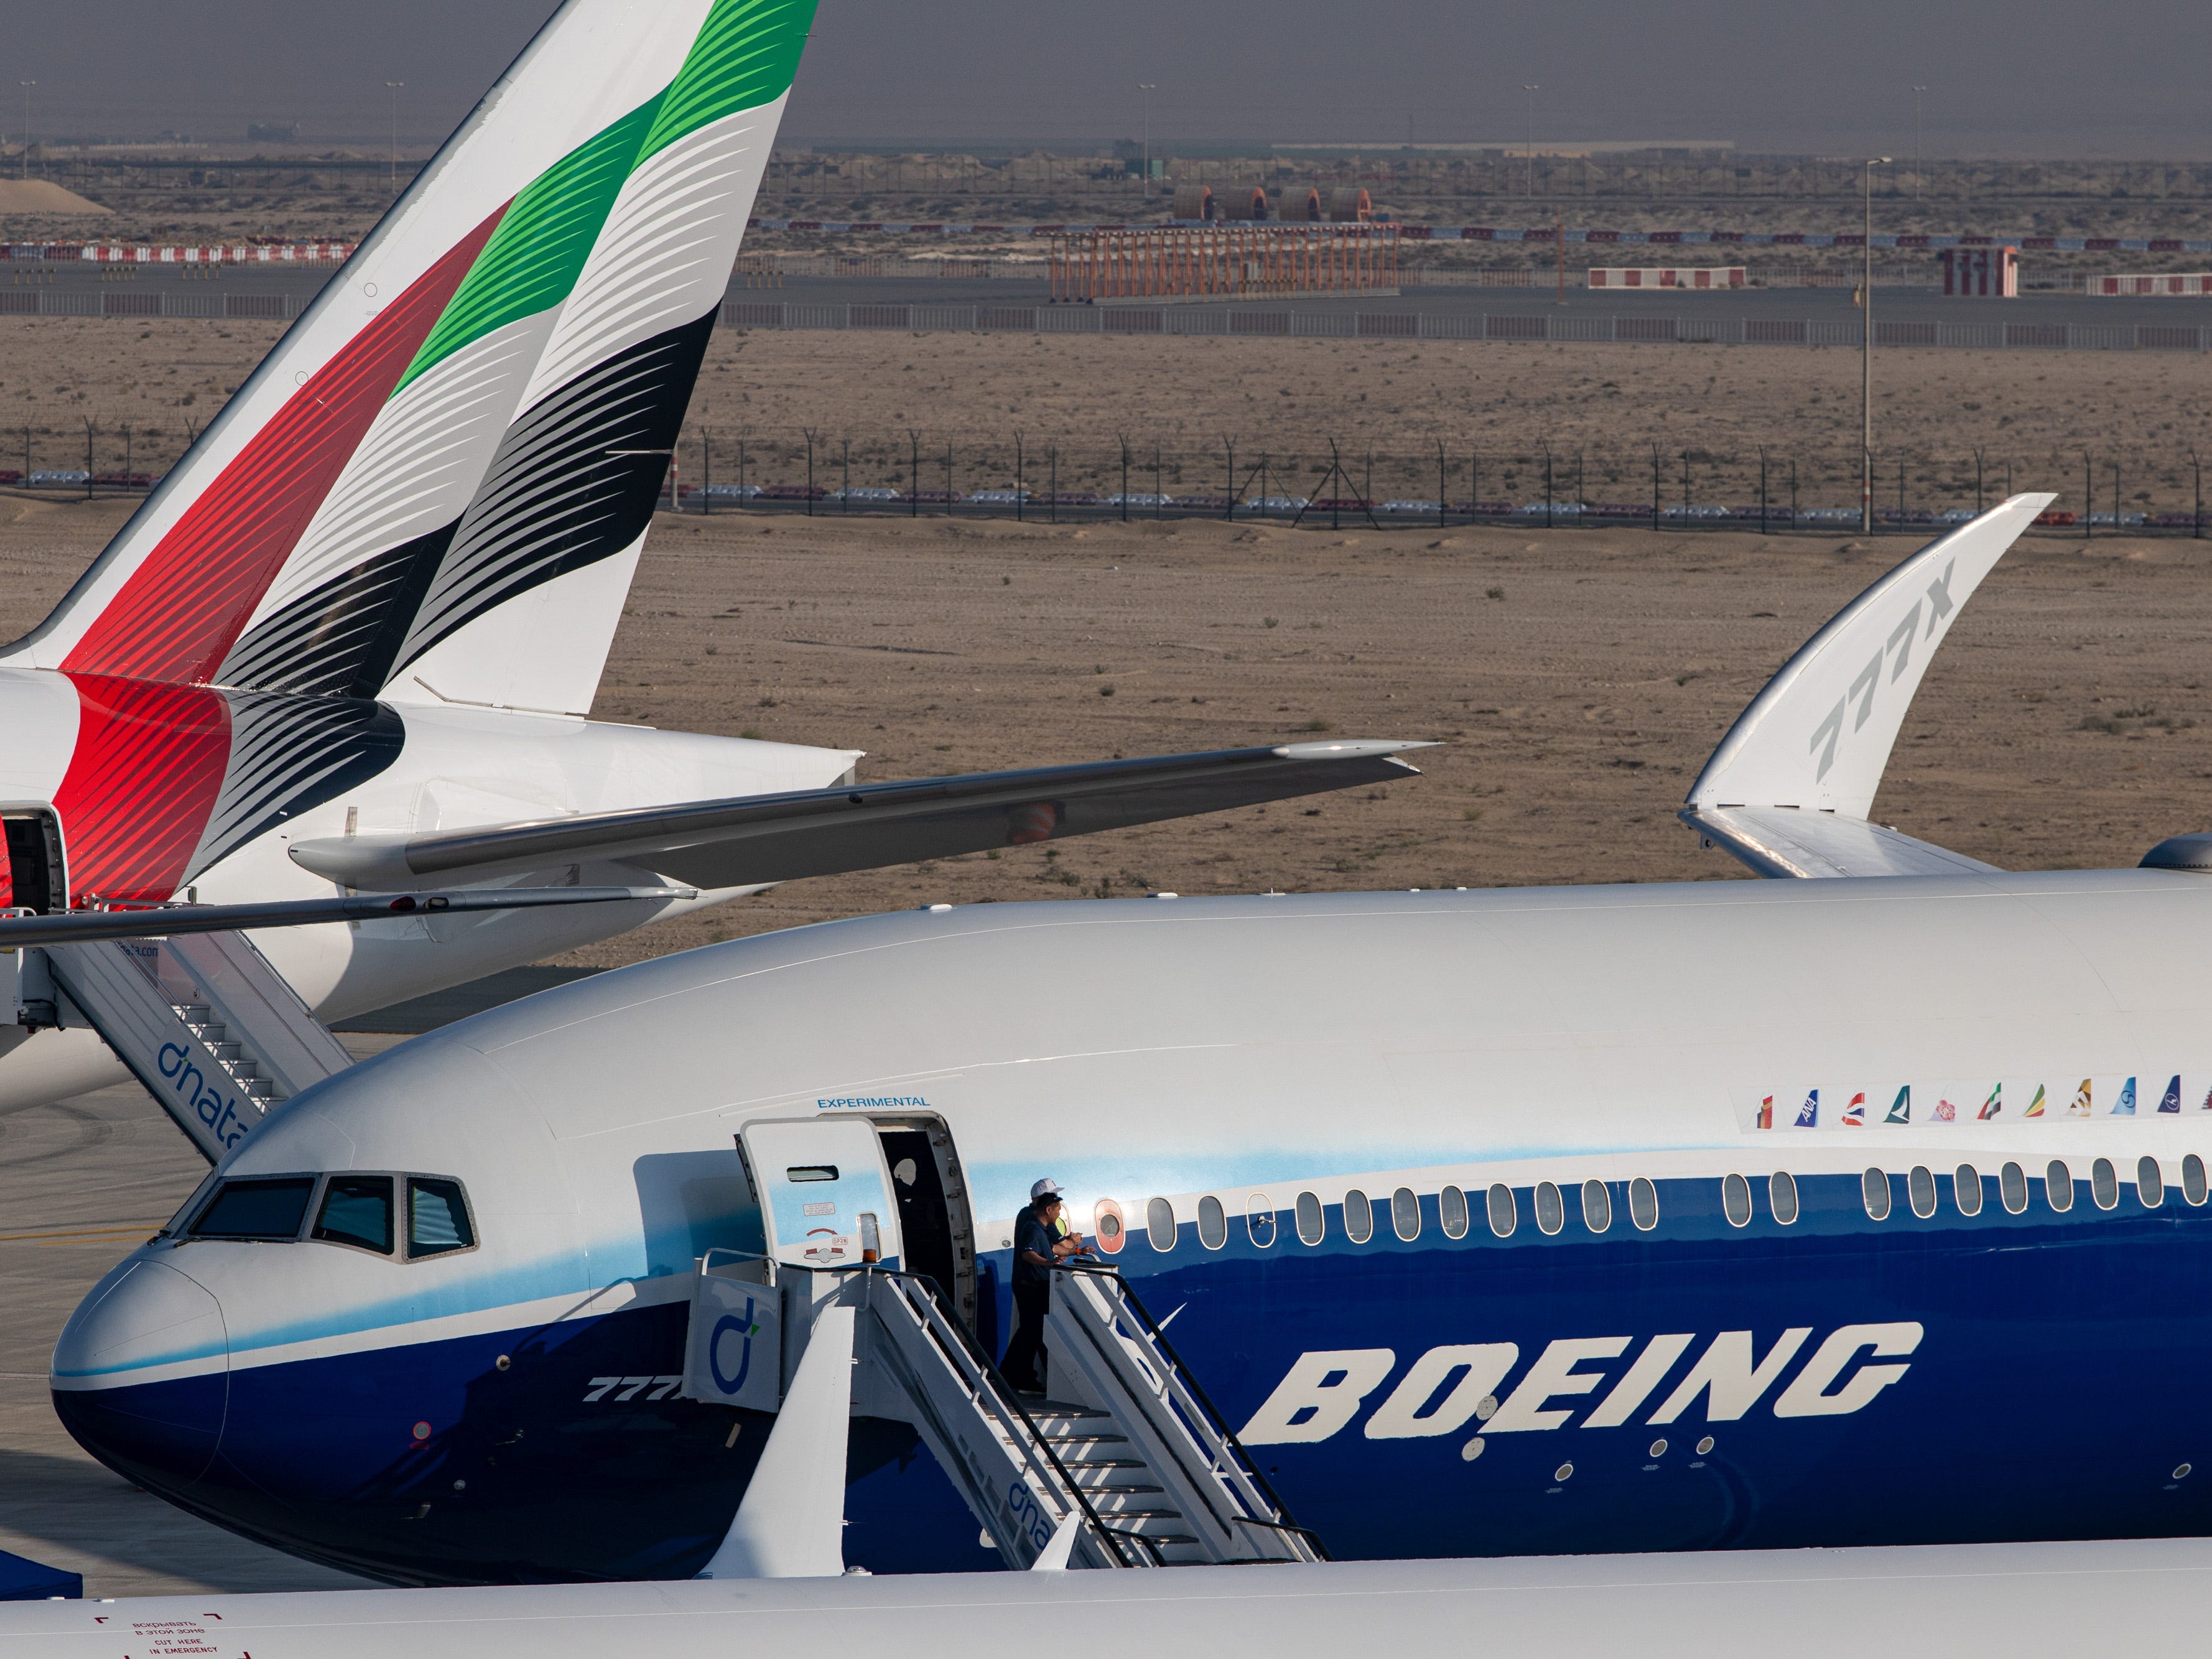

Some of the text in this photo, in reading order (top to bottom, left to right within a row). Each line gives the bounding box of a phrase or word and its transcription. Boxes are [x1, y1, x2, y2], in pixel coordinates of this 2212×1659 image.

[1810, 556, 1956, 785] 777X
[817, 1097, 931, 1108] EXPERIMENTAL
[1801, 1097, 1817, 1122] ANA
[582, 1375, 683, 1401] 777
[1235, 1321, 1924, 1446] BOEING
[1009, 1482, 1051, 1551] dna
